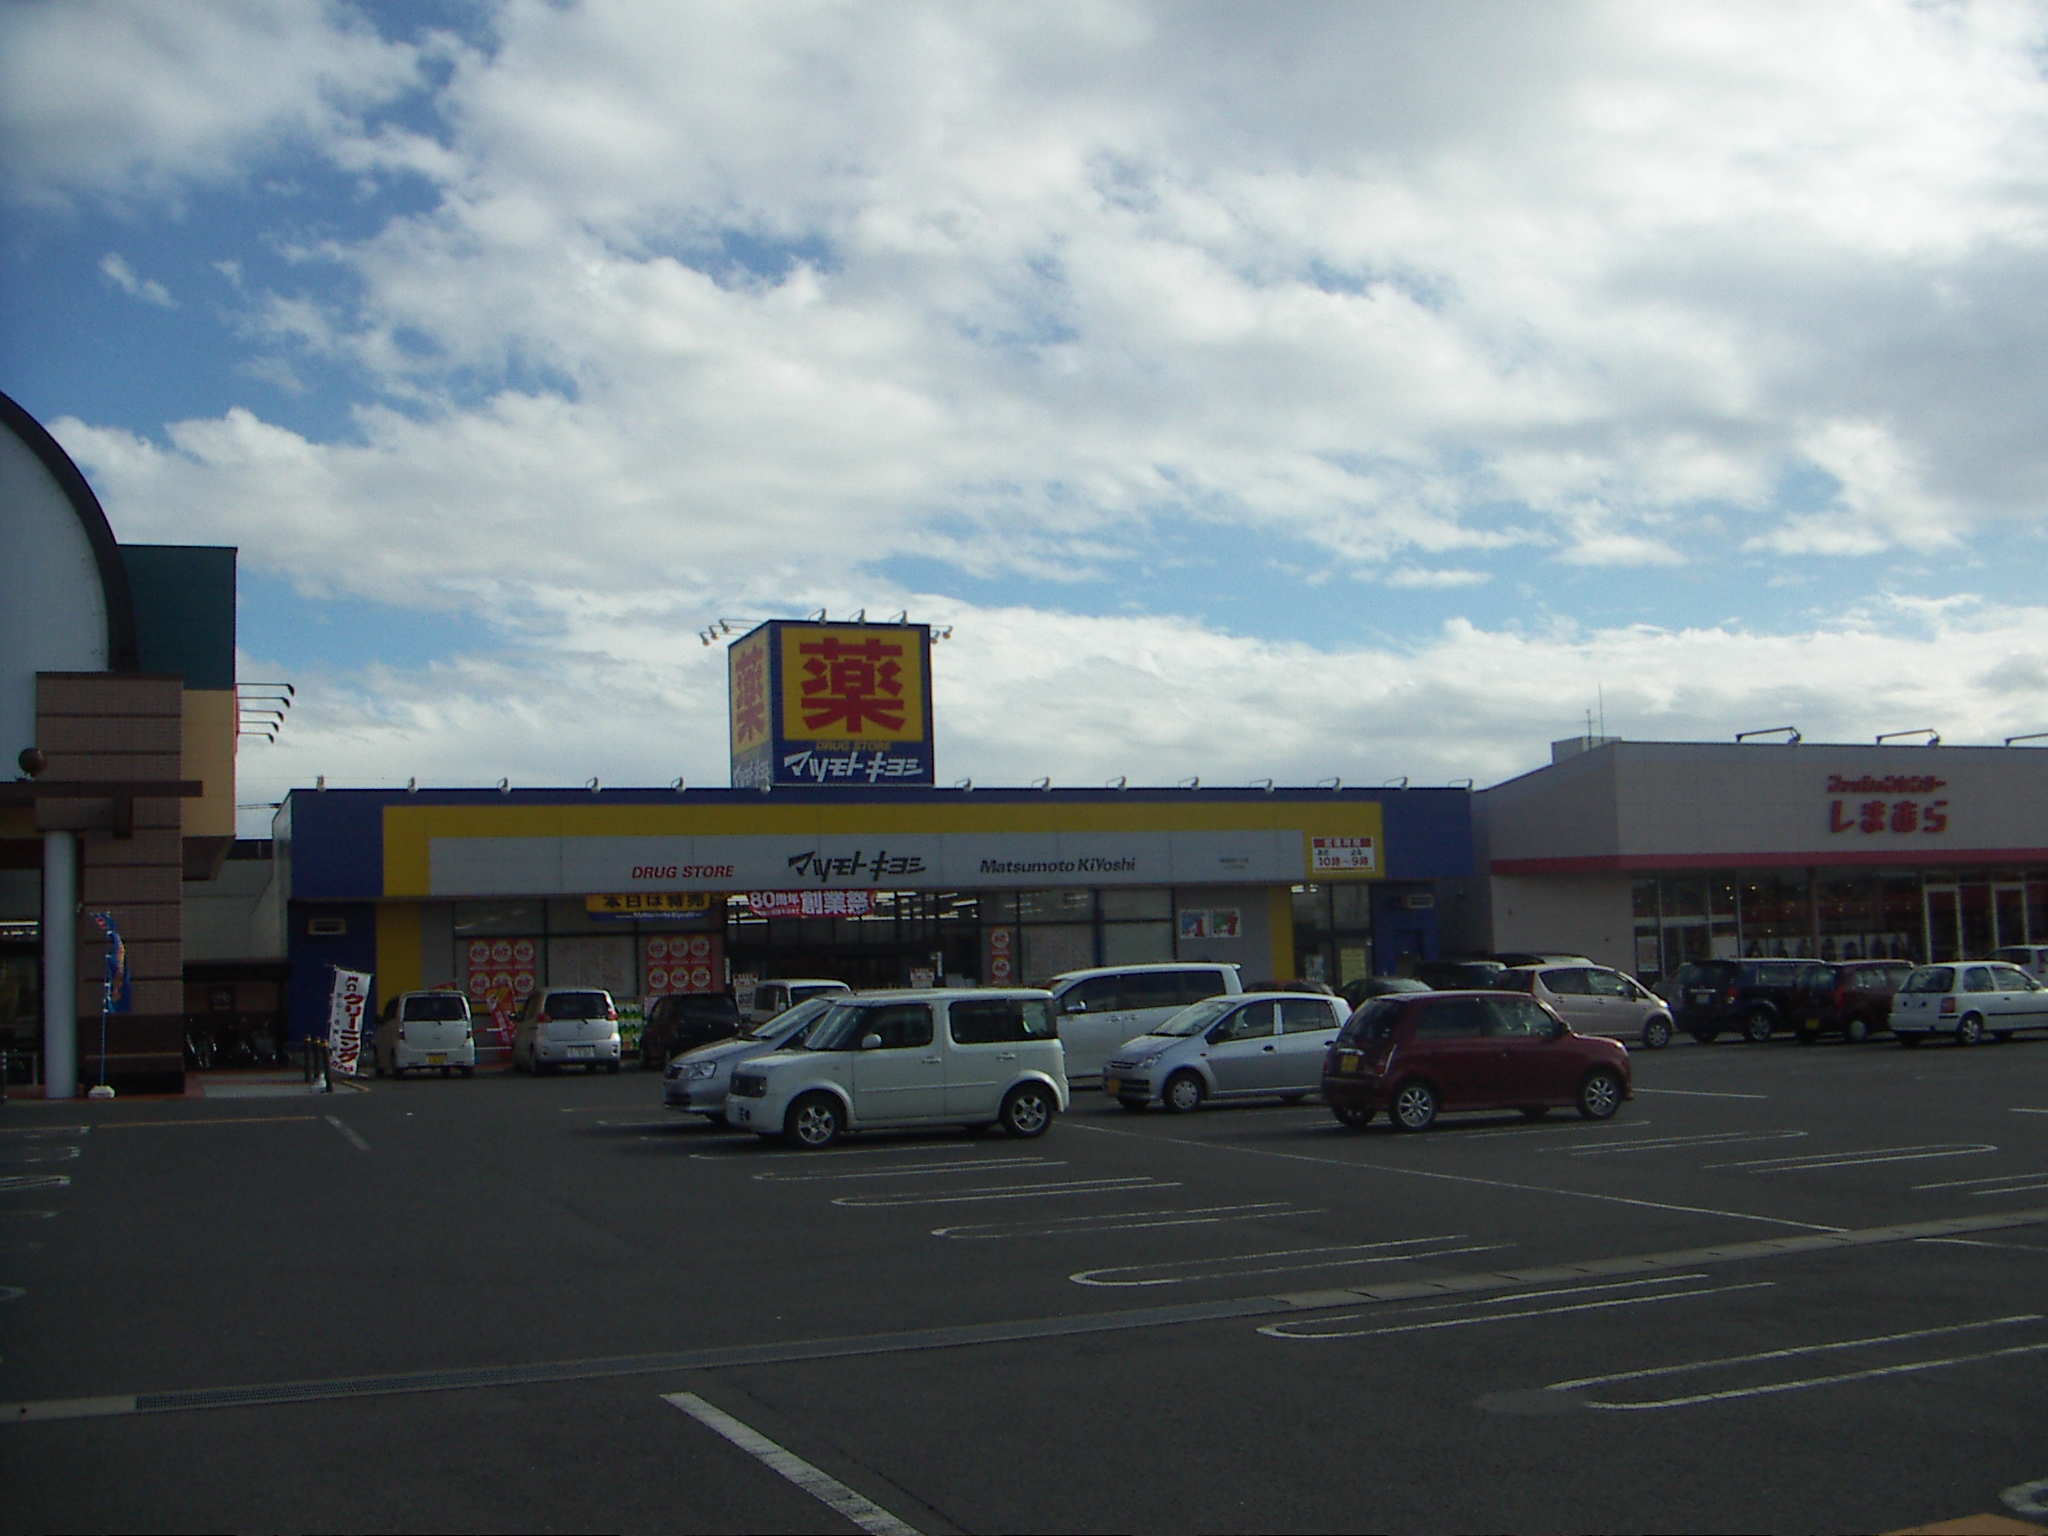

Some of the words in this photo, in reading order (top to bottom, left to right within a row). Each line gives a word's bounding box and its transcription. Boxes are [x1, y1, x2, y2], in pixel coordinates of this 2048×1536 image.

[735, 645, 765, 744] 薬
[800, 637, 907, 733] 薬
[784, 750, 924, 783] マツモトキヨシ
[1831, 800, 1948, 833] しまむら
[632, 865, 677, 879] DRUG
[682, 865, 735, 879] STORE
[788, 851, 926, 882] マツモトキヨシ
[980, 859, 1075, 873] Matsumoto
